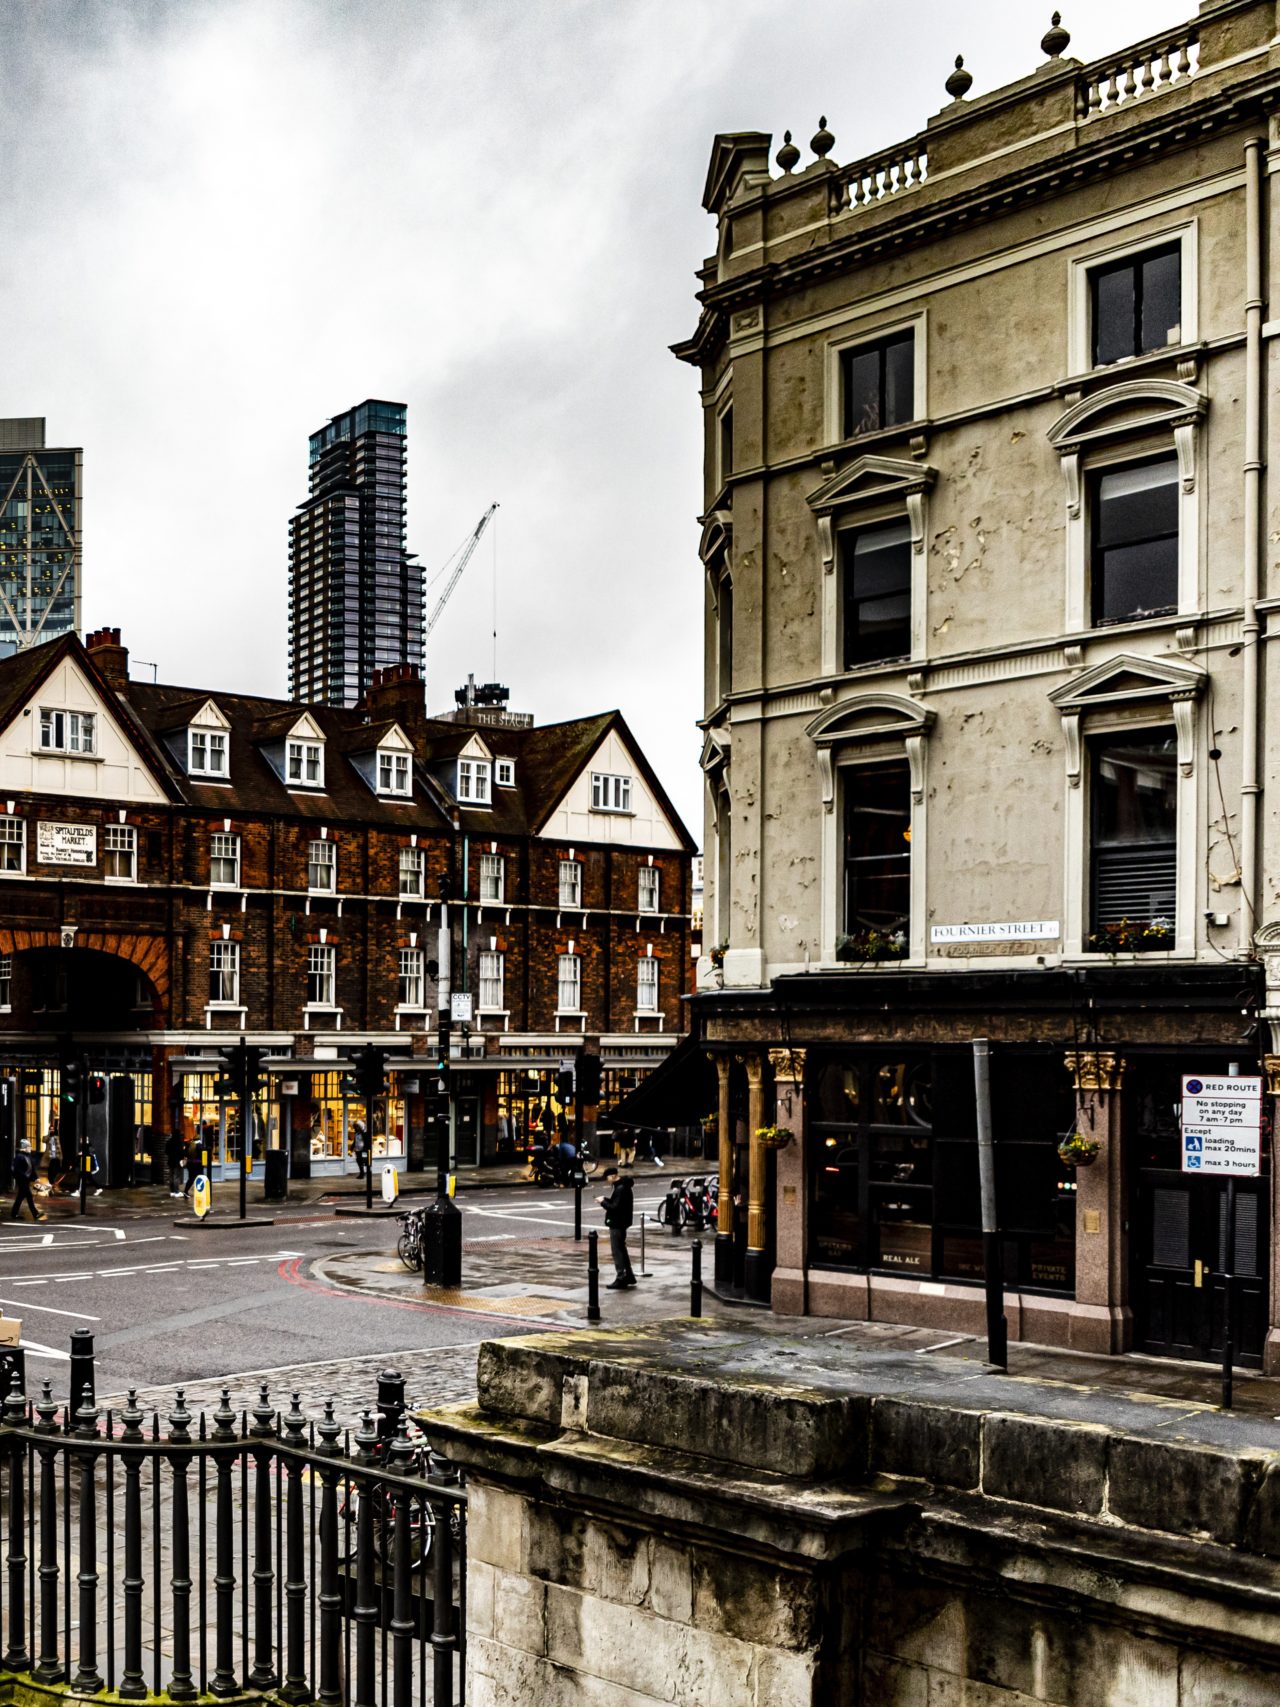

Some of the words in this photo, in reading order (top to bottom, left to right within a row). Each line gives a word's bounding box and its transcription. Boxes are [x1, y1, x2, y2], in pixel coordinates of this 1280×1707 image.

[477, 713, 497, 725] THE
[55, 826, 93, 836] SPITALFIELDS
[934, 925, 996, 937] FOURNIER
[999, 923, 1046, 934] STREET
[1226, 1084, 1258, 1092] ROUTE
[1210, 1101, 1246, 1109] stopping
[1184, 1127, 1212, 1135] Except
[1205, 1137, 1235, 1145] loading
[883, 1254, 902, 1263] REAL
[905, 1256, 920, 1265] ALE
[1032, 1263, 1067, 1274] PRIVATE
[1032, 1272, 1066, 1281] EVENTS
